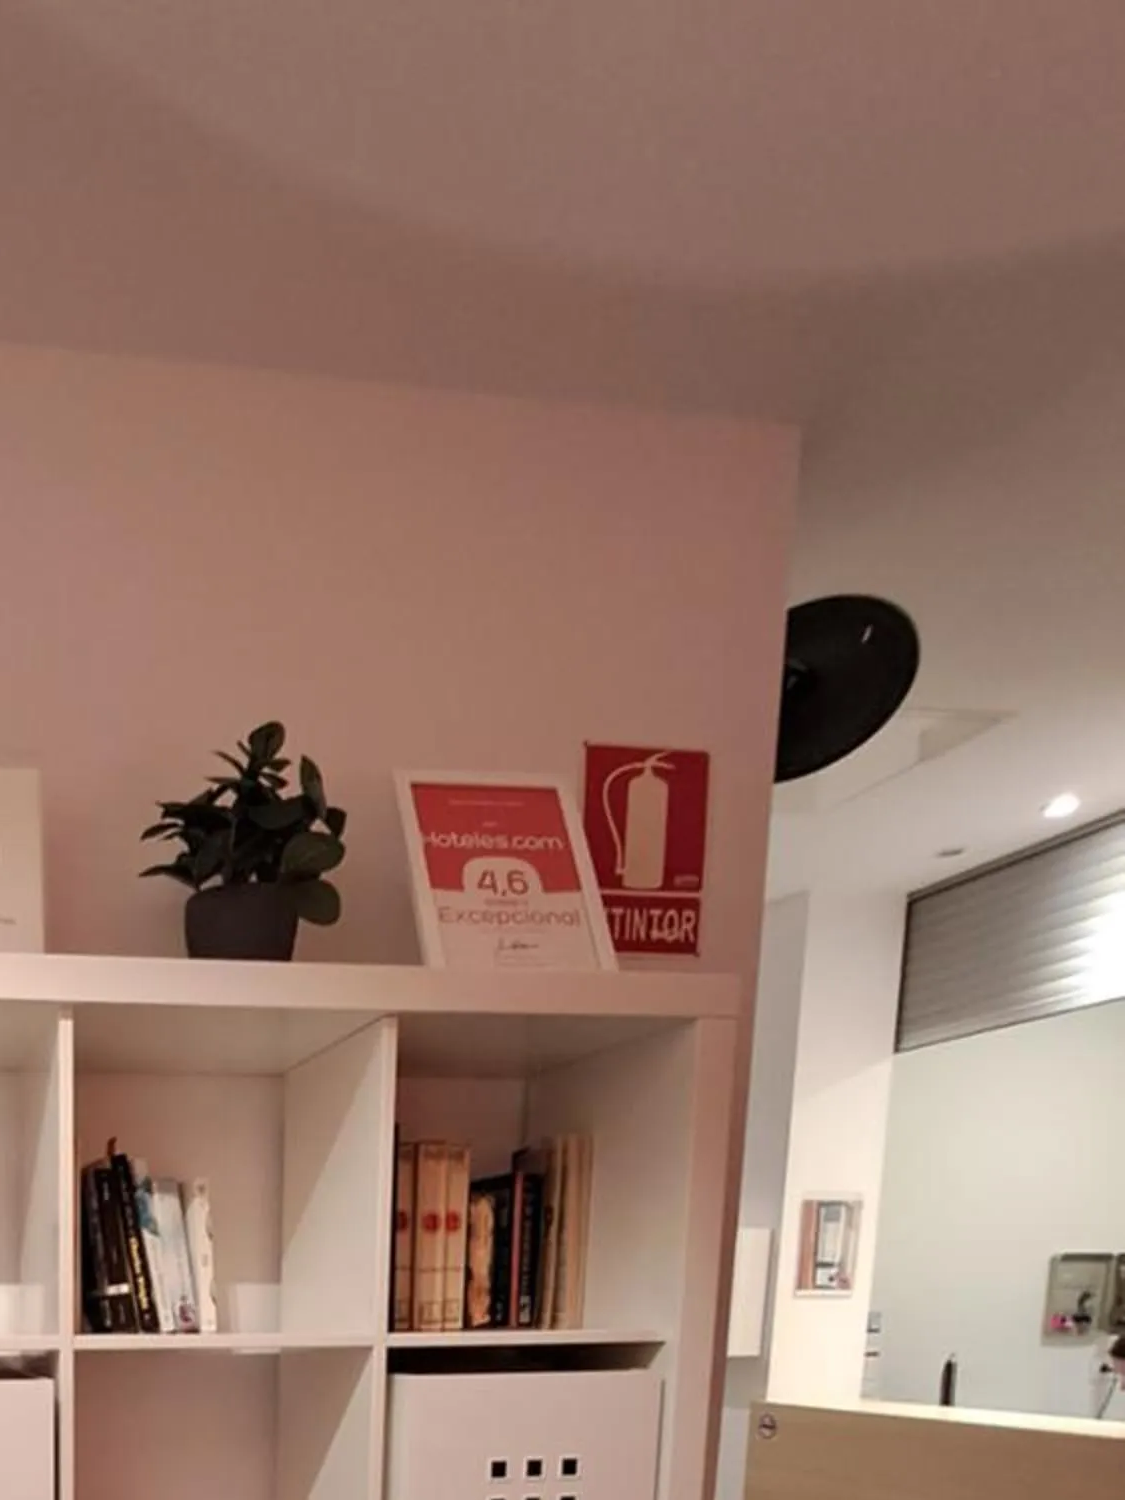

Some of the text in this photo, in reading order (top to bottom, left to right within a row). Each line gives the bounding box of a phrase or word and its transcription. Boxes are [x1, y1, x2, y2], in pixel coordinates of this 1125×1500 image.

[477, 869, 530, 897] 4,6
[438, 906, 581, 928] Excepcional
[605, 906, 696, 943] TINTOR
